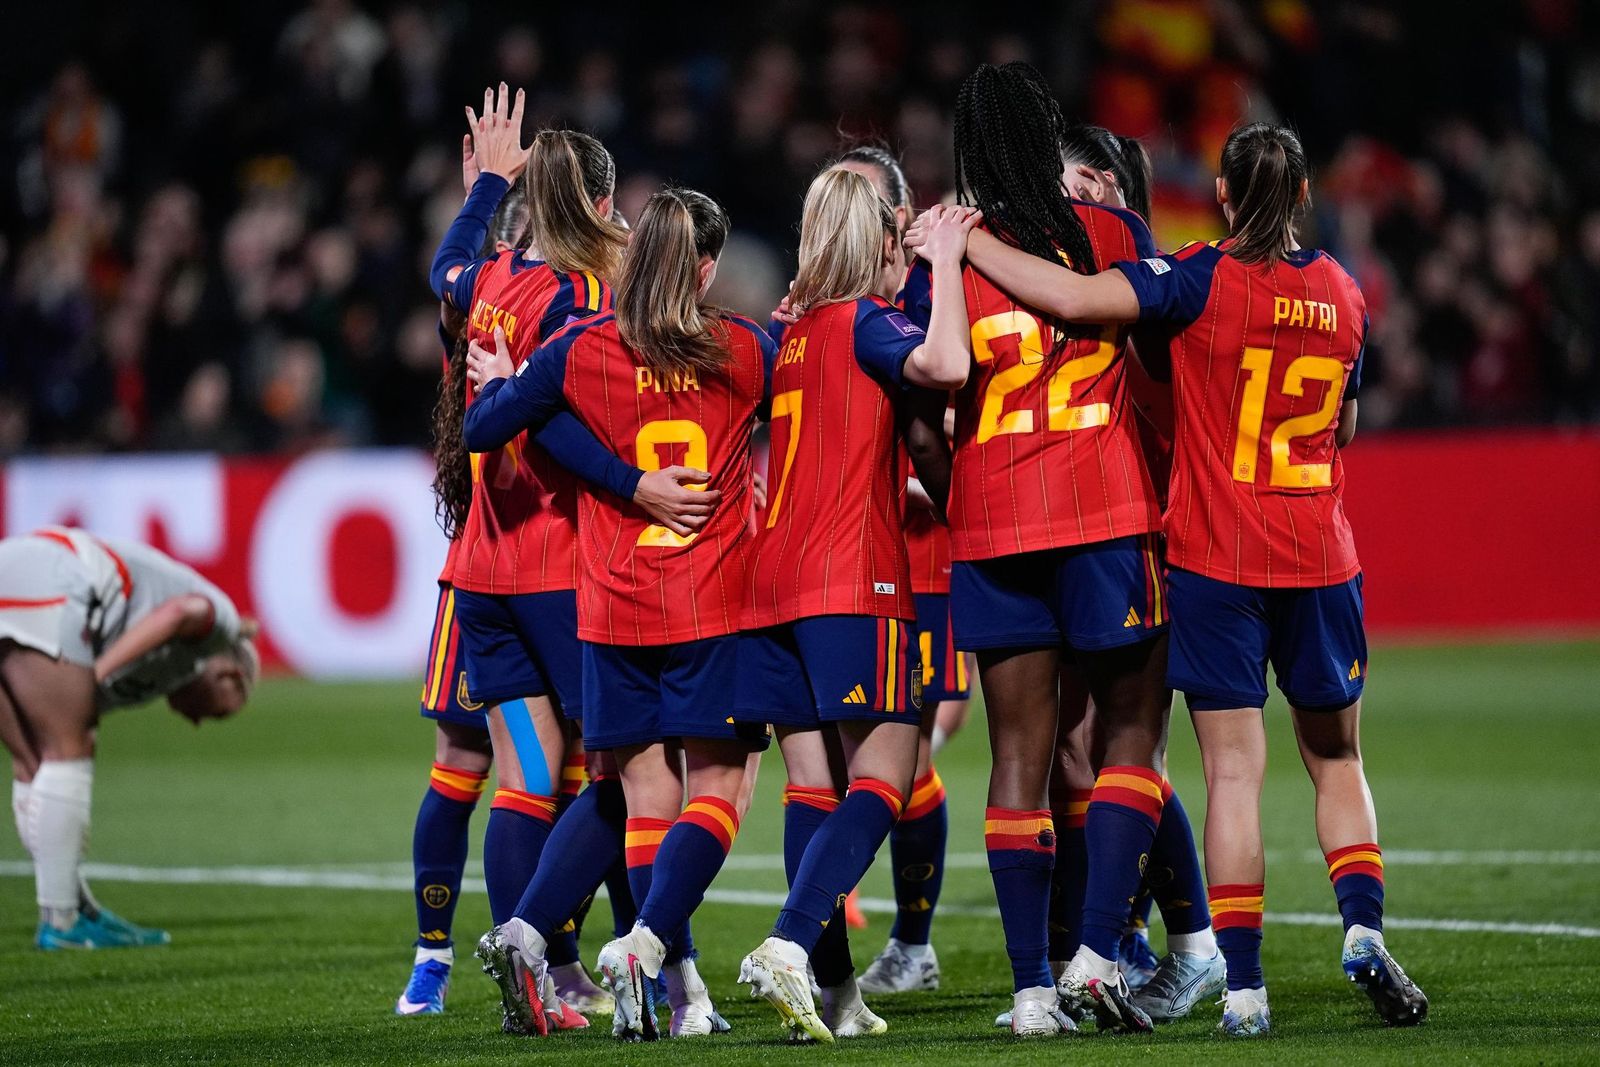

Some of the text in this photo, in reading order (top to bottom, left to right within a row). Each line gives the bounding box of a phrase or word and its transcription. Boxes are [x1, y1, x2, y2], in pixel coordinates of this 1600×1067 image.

[470, 298, 518, 344] ALEXIA
[970, 311, 1115, 444] 22
[1274, 296, 1338, 332] PATRI
[767, 389, 803, 528] 7
[1232, 347, 1345, 488] 12
